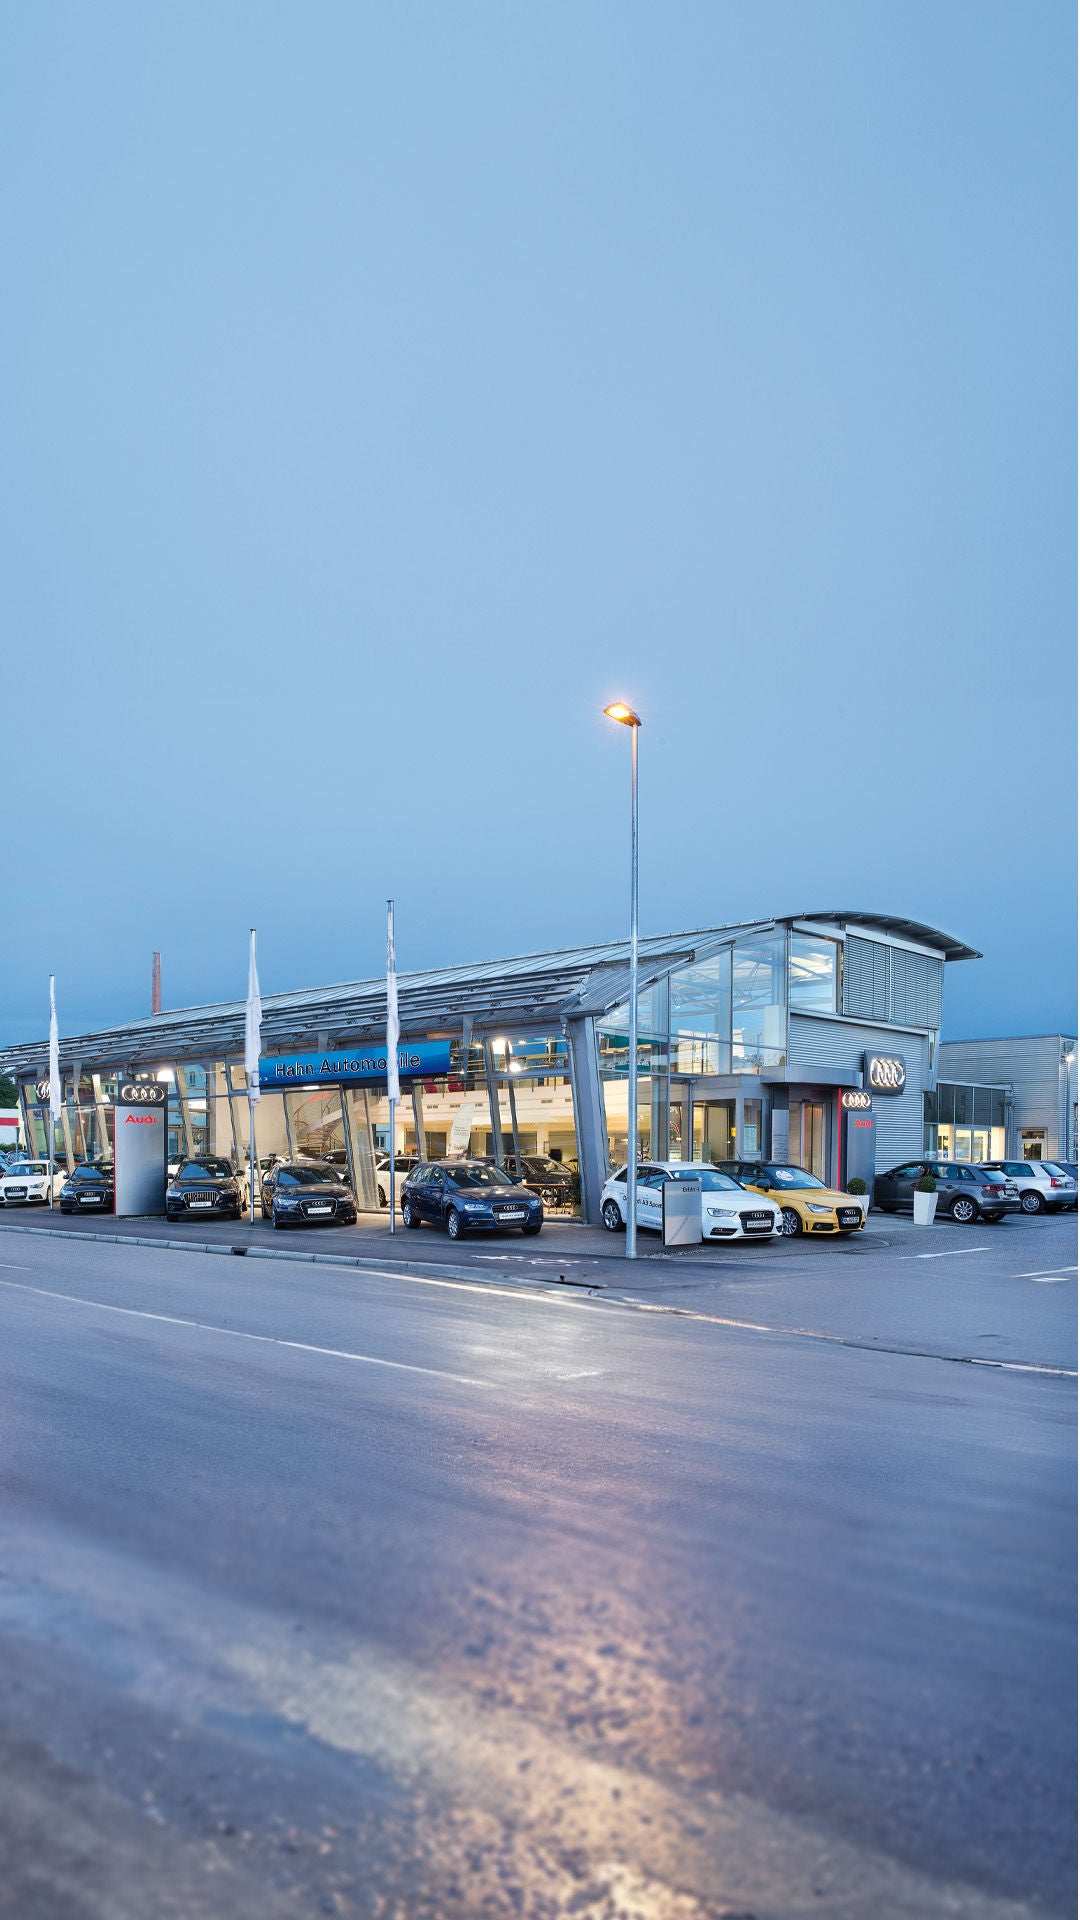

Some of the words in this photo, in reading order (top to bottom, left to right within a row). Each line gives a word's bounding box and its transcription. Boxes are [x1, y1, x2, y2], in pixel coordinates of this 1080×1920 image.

[275, 1062, 314, 1078] Hahn
[319, 1051, 420, 1074] Automoile
[125, 1113, 157, 1125] Audi
